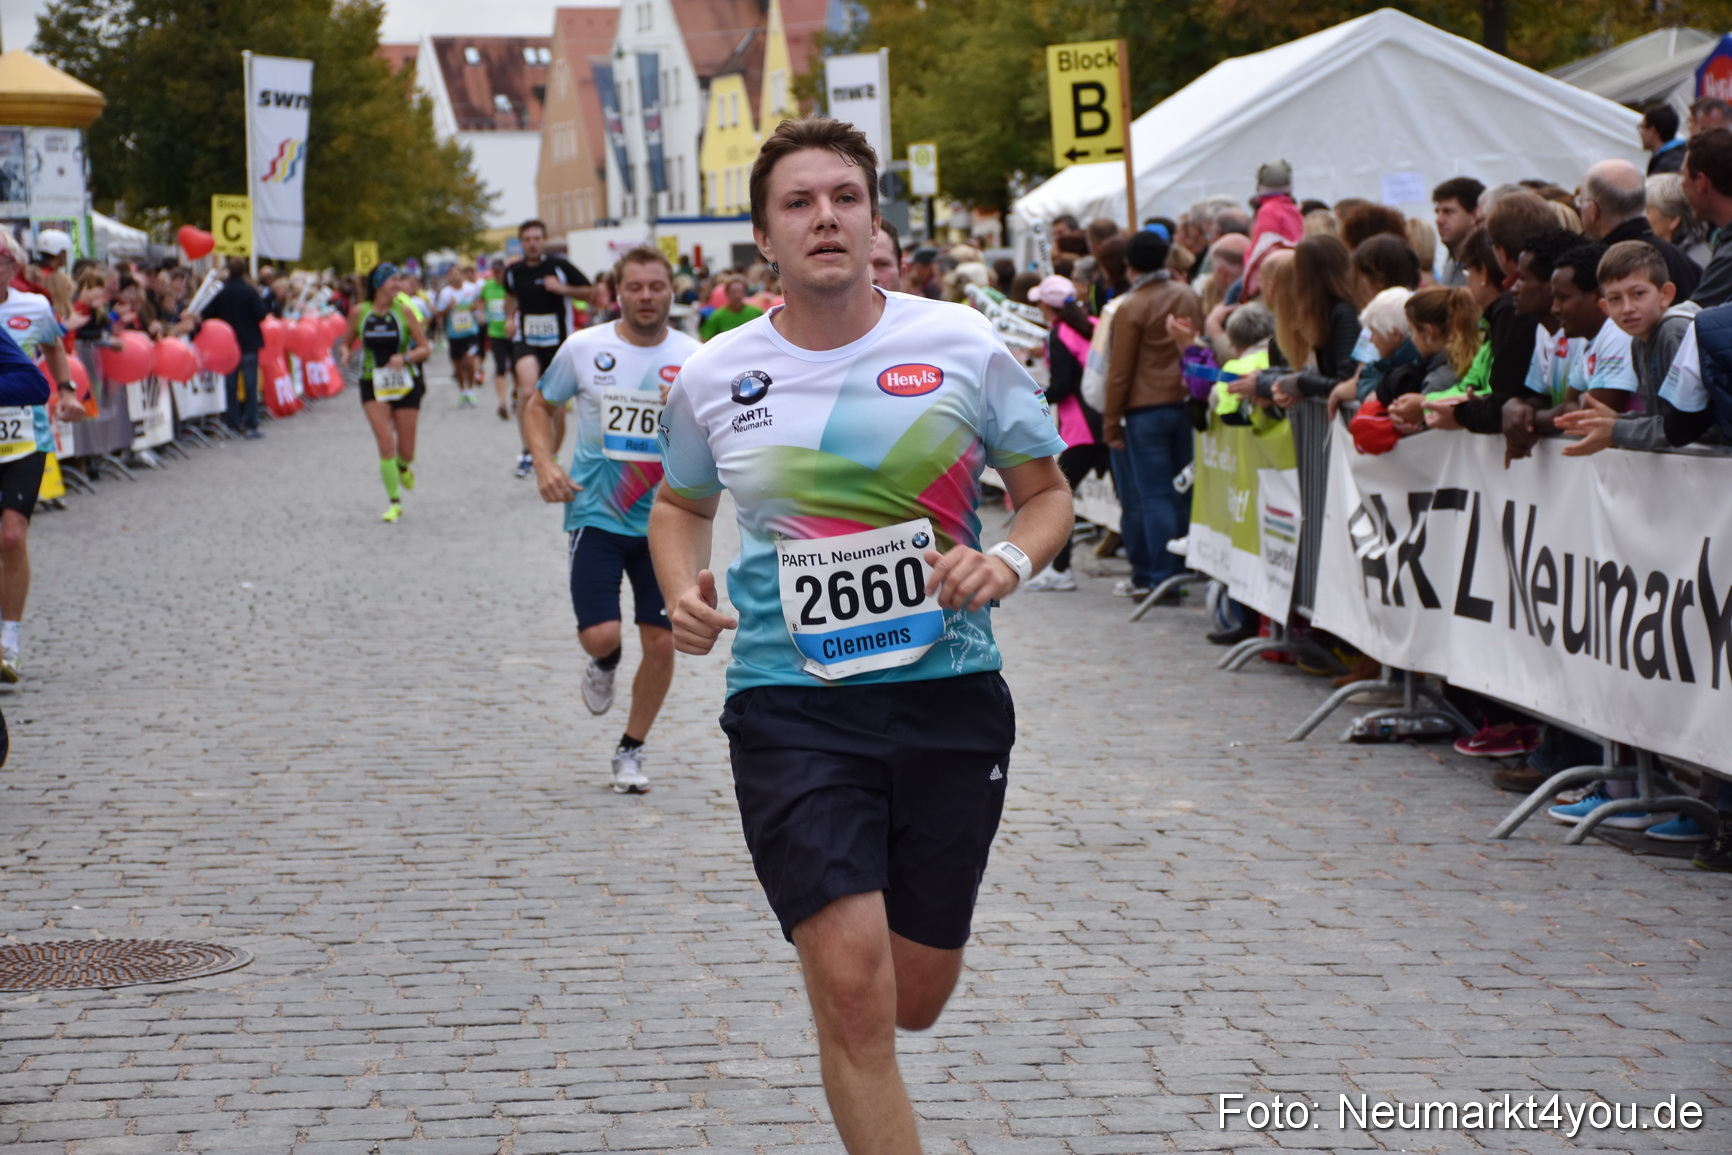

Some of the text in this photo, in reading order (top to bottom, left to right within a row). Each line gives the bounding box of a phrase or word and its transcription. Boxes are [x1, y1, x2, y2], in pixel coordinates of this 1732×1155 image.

[1058, 47, 1119, 72] Block
[1071, 81, 1111, 138] B
[222, 213, 241, 242] C
[886, 370, 937, 387] Hervis
[732, 407, 773, 426] PARTL
[733, 418, 773, 434] Neumarkt
[625, 439, 649, 452] Rudi
[781, 539, 906, 567] PARTL Neumarkt
[795, 556, 926, 626] 2660
[823, 627, 912, 659] Clemens
